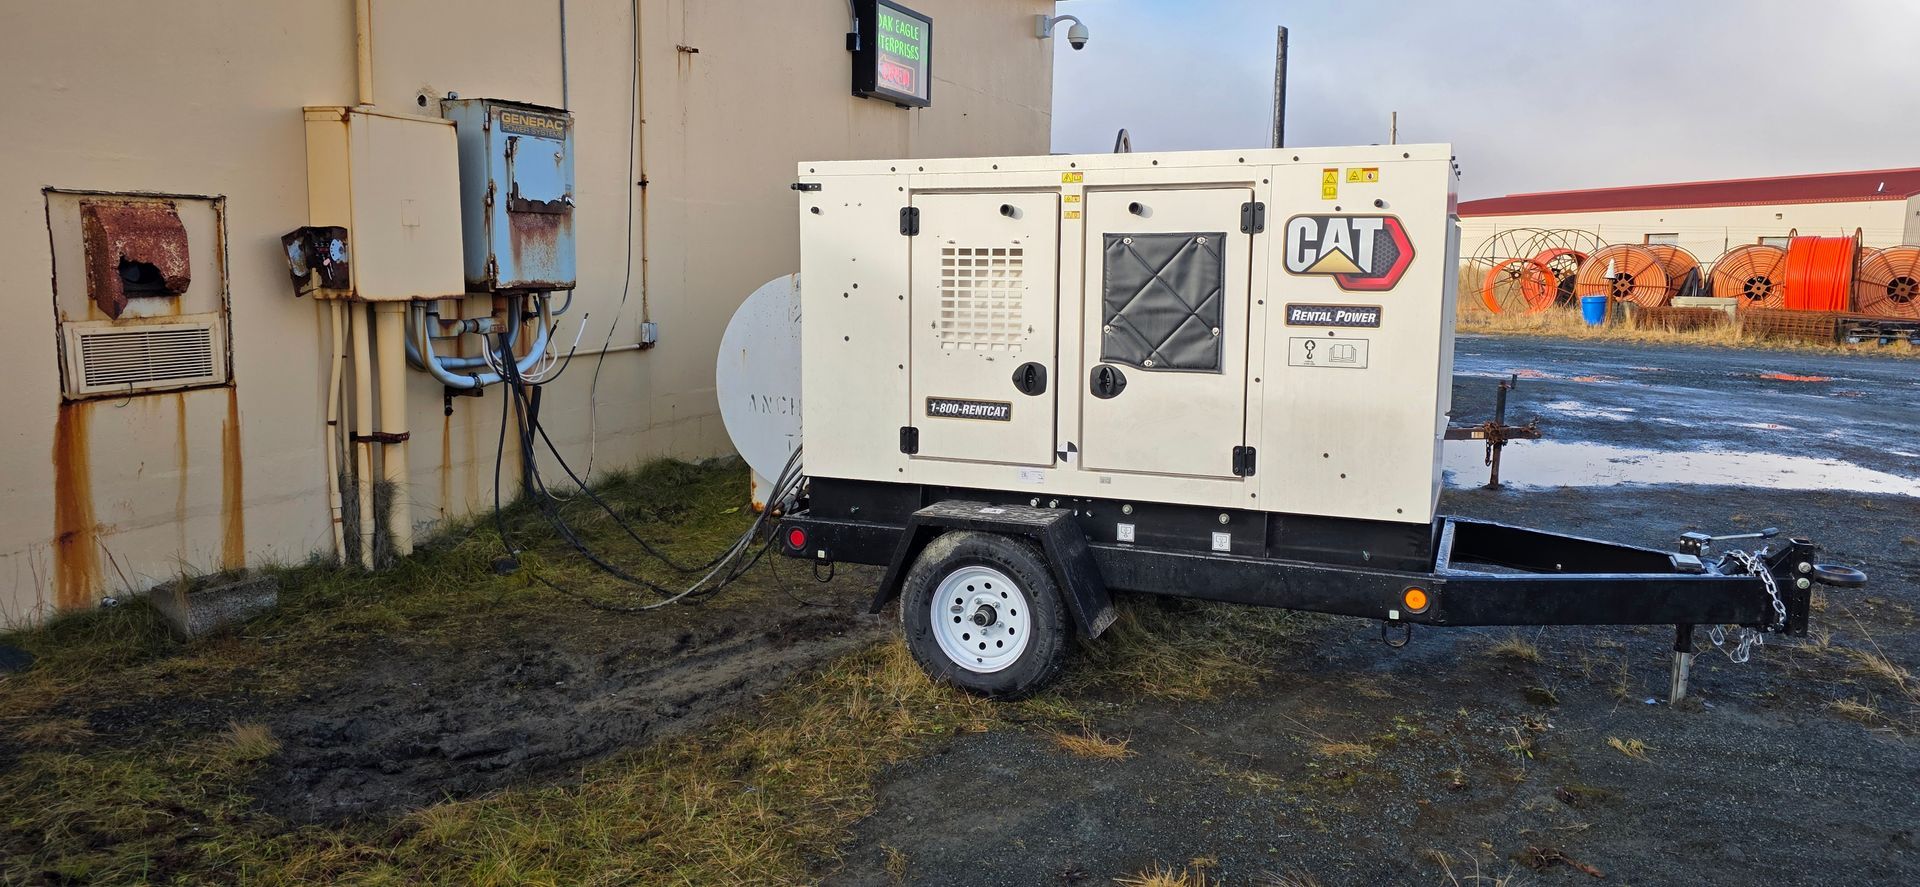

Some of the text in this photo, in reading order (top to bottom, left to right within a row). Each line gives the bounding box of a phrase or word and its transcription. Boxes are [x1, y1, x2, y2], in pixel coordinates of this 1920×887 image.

[896, 20, 919, 41] EAGLE
[501, 112, 563, 130] GENERAC
[503, 125, 530, 133] POWER
[1287, 217, 1383, 273] CAT
[931, 402, 1008, 417] 1-800-RENTCAT
